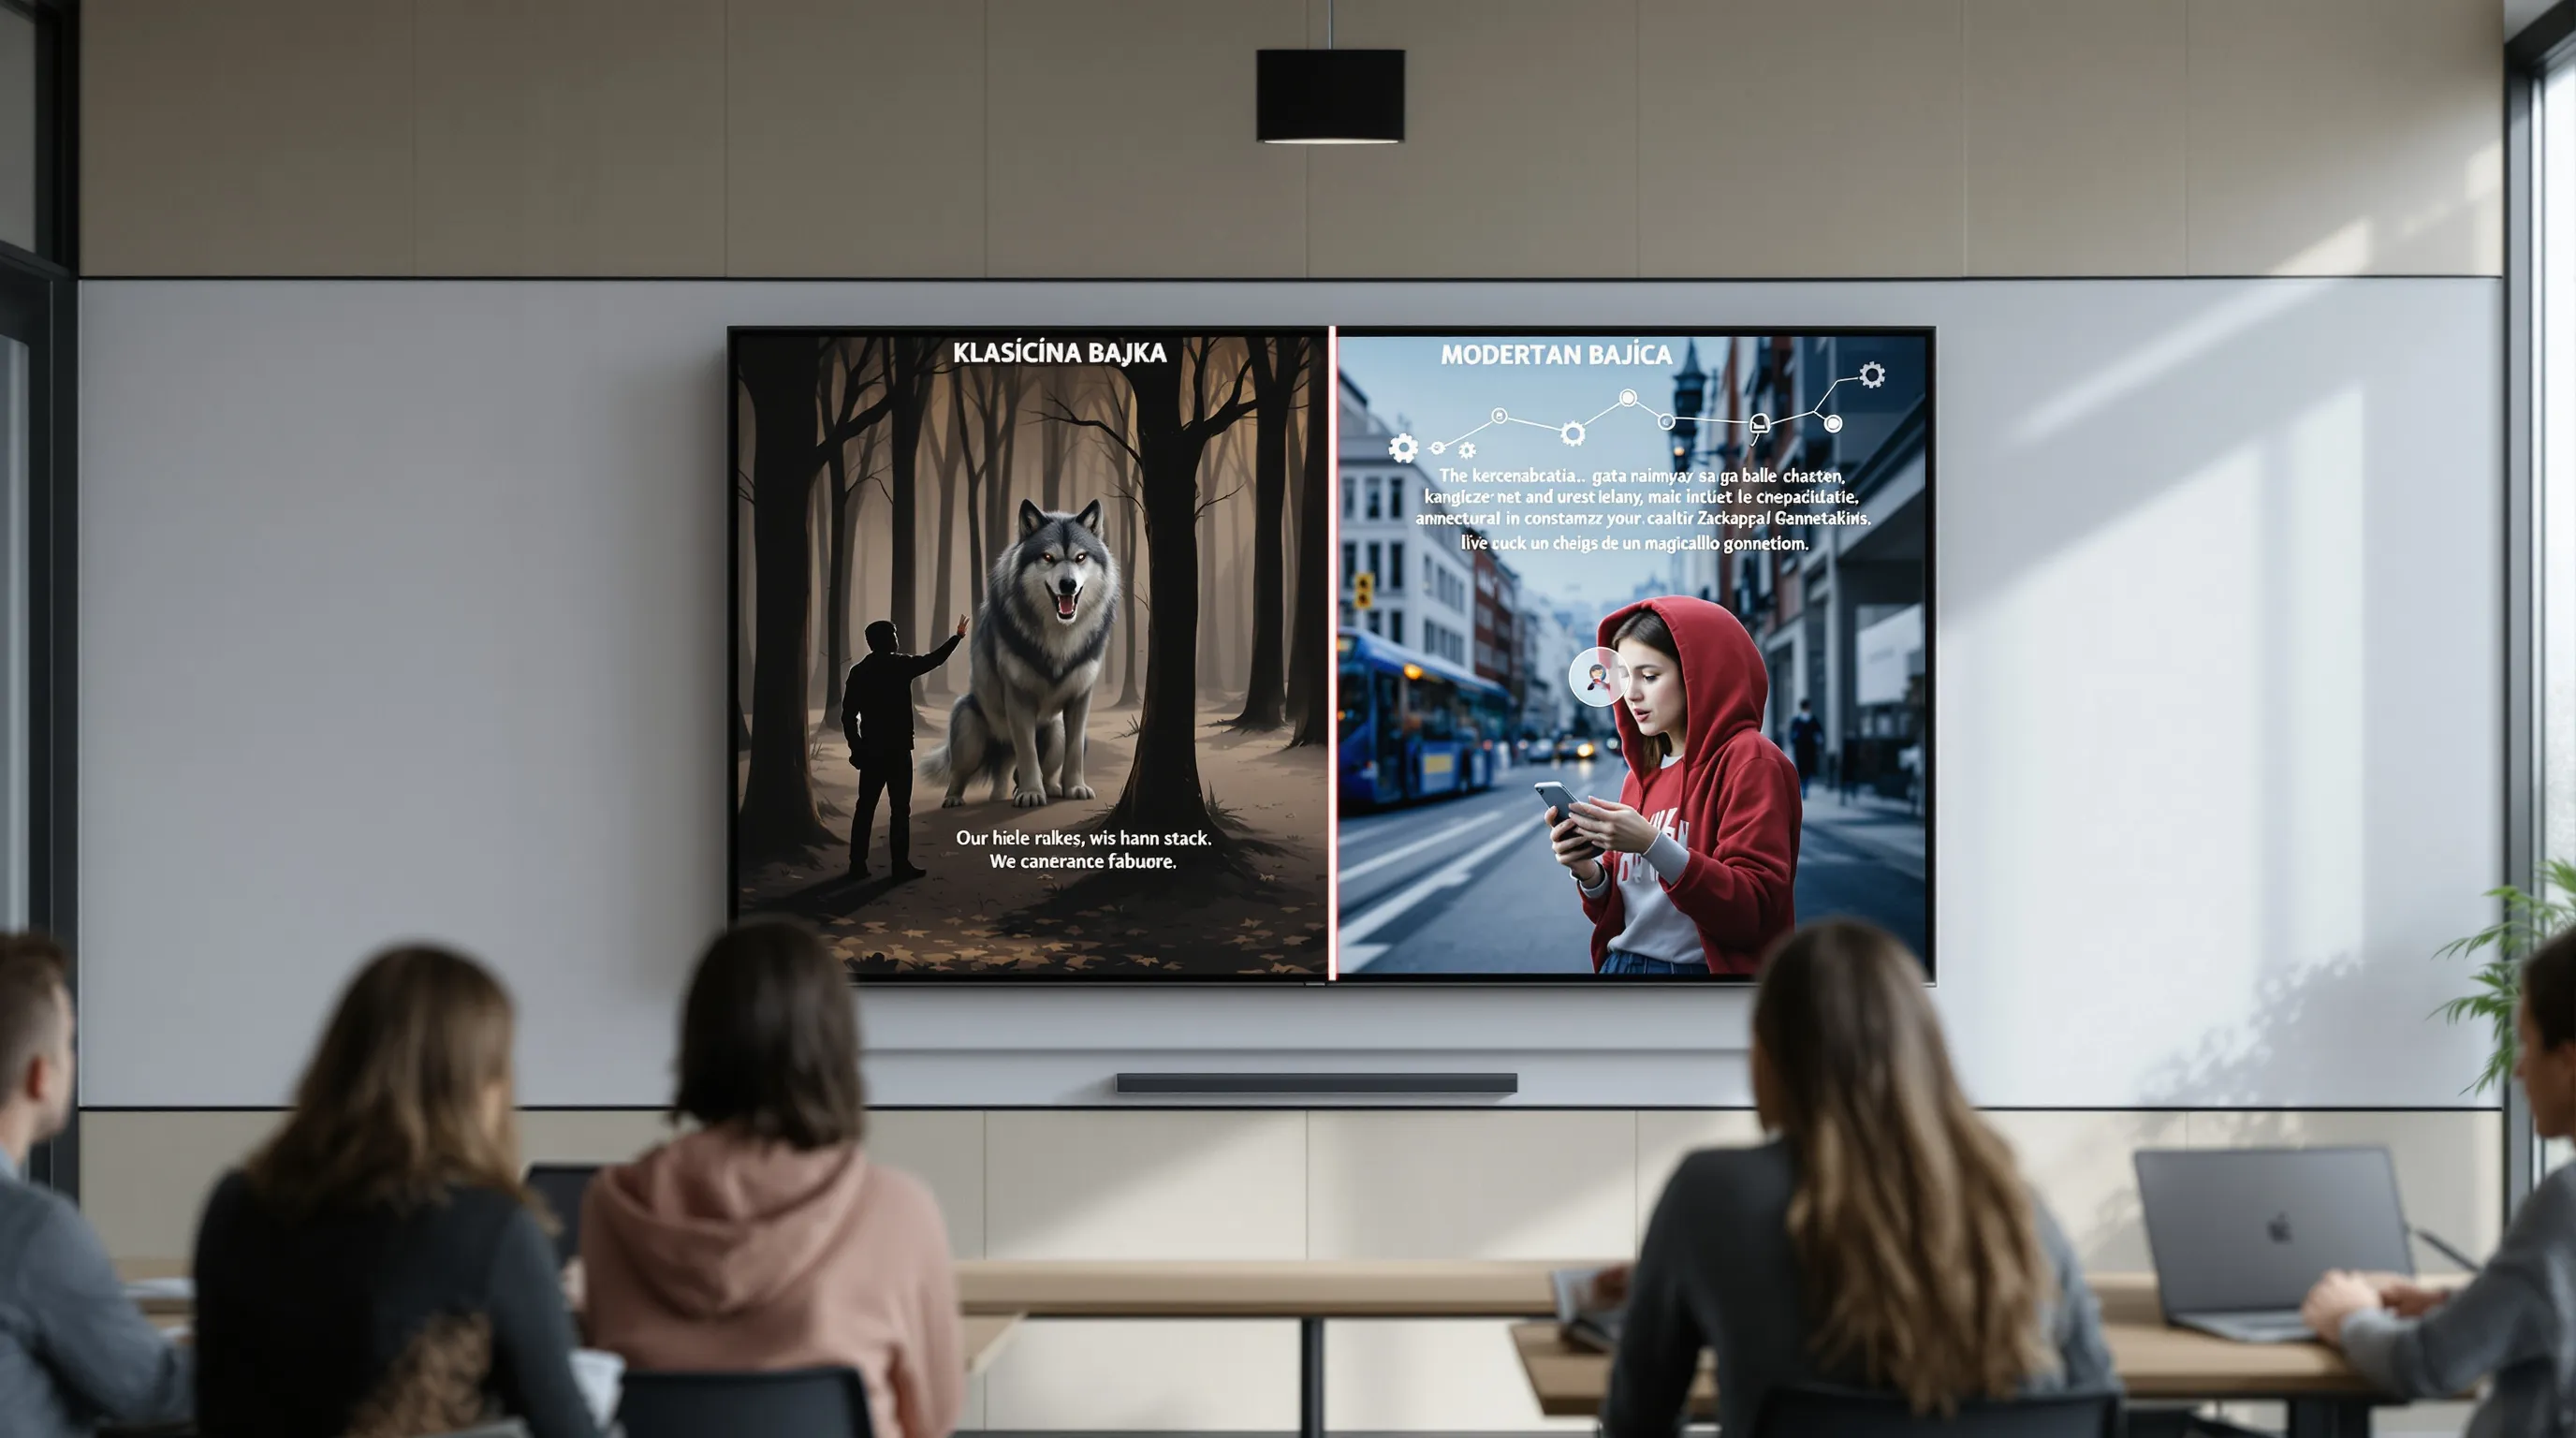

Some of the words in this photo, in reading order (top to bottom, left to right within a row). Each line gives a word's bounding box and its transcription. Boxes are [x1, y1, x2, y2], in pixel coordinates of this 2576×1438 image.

[1089, 342, 1167, 367] BAJKA
[1442, 344, 1582, 365] MODERTAN
[1440, 468, 1468, 483] The
[1592, 469, 1627, 487] gata
[1742, 467, 1778, 483] balle
[1497, 491, 1522, 504] net
[1526, 489, 1554, 504] and
[1506, 511, 1520, 525] in
[1602, 536, 1619, 550] de
[1622, 537, 1641, 550] un
[956, 829, 988, 845] Our
[1089, 829, 1117, 845] wis
[1120, 829, 1160, 845] hann
[1164, 829, 1213, 845] stack.
[989, 854, 1017, 869] We
